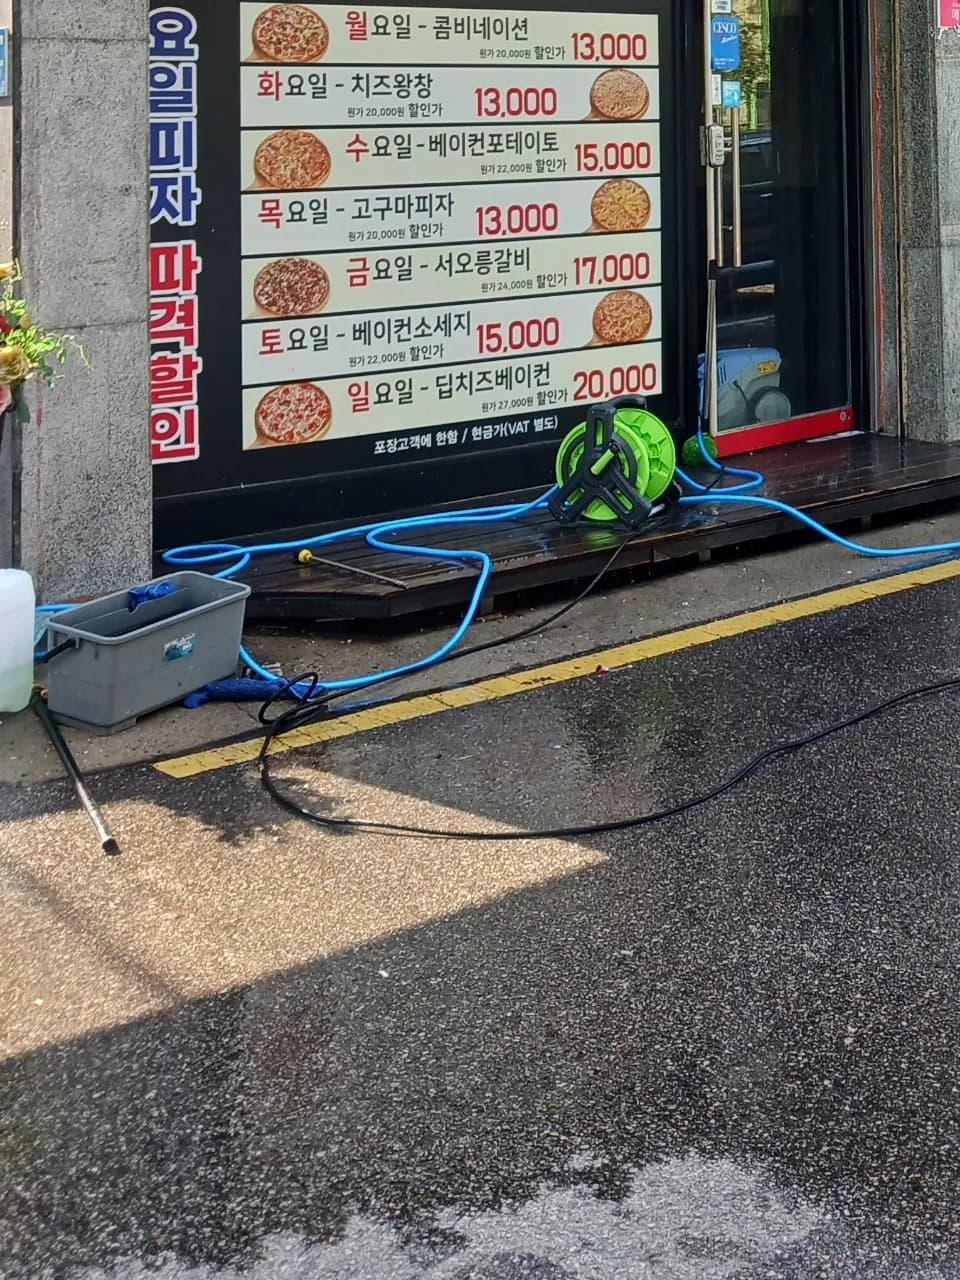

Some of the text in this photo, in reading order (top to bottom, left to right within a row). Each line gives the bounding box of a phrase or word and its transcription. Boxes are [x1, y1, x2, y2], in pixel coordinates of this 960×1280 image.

[345, 10, 411, 40] 월요일
[433, 16, 529, 41] 콤비네이션
[534, 46, 565, 60] 할인가
[571, 32, 648, 62] 13,000
[257, 70, 328, 101] 화요일
[351, 73, 433, 99] 치즈왕창
[408, 103, 443, 118] 할인가
[474, 87, 558, 118] 13,000
[345, 133, 412, 162] 수요일
[429, 130, 559, 158] 베이컨포테이토
[535, 158, 567, 173] 할인가
[574, 142, 651, 172] 15,000
[258, 198, 328, 229] 목요일
[351, 192, 454, 220] 고구마피자
[409, 222, 443, 239] 할인가
[475, 203, 558, 236] 13,000
[149, 6, 203, 465] 요일피자 파격할인
[346, 255, 413, 287] 금요일
[435, 246, 530, 277] 서오릉갈비
[536, 273, 568, 288] 할인가
[573, 252, 650, 286] 17,000
[258, 324, 328, 355] 토요일
[352, 311, 471, 345] 베이컨소세지
[410, 344, 444, 361] 할인가
[476, 317, 559, 354] 15,000
[348, 378, 413, 413] 일요일
[436, 362, 551, 399] 딥치즈베이컨
[536, 389, 568, 406] 할인가
[573, 363, 657, 401] 20,000
[373, 433, 432, 455] 포장고객에
[435, 430, 458, 446] 한함
[533, 415, 559, 432] 별도)
